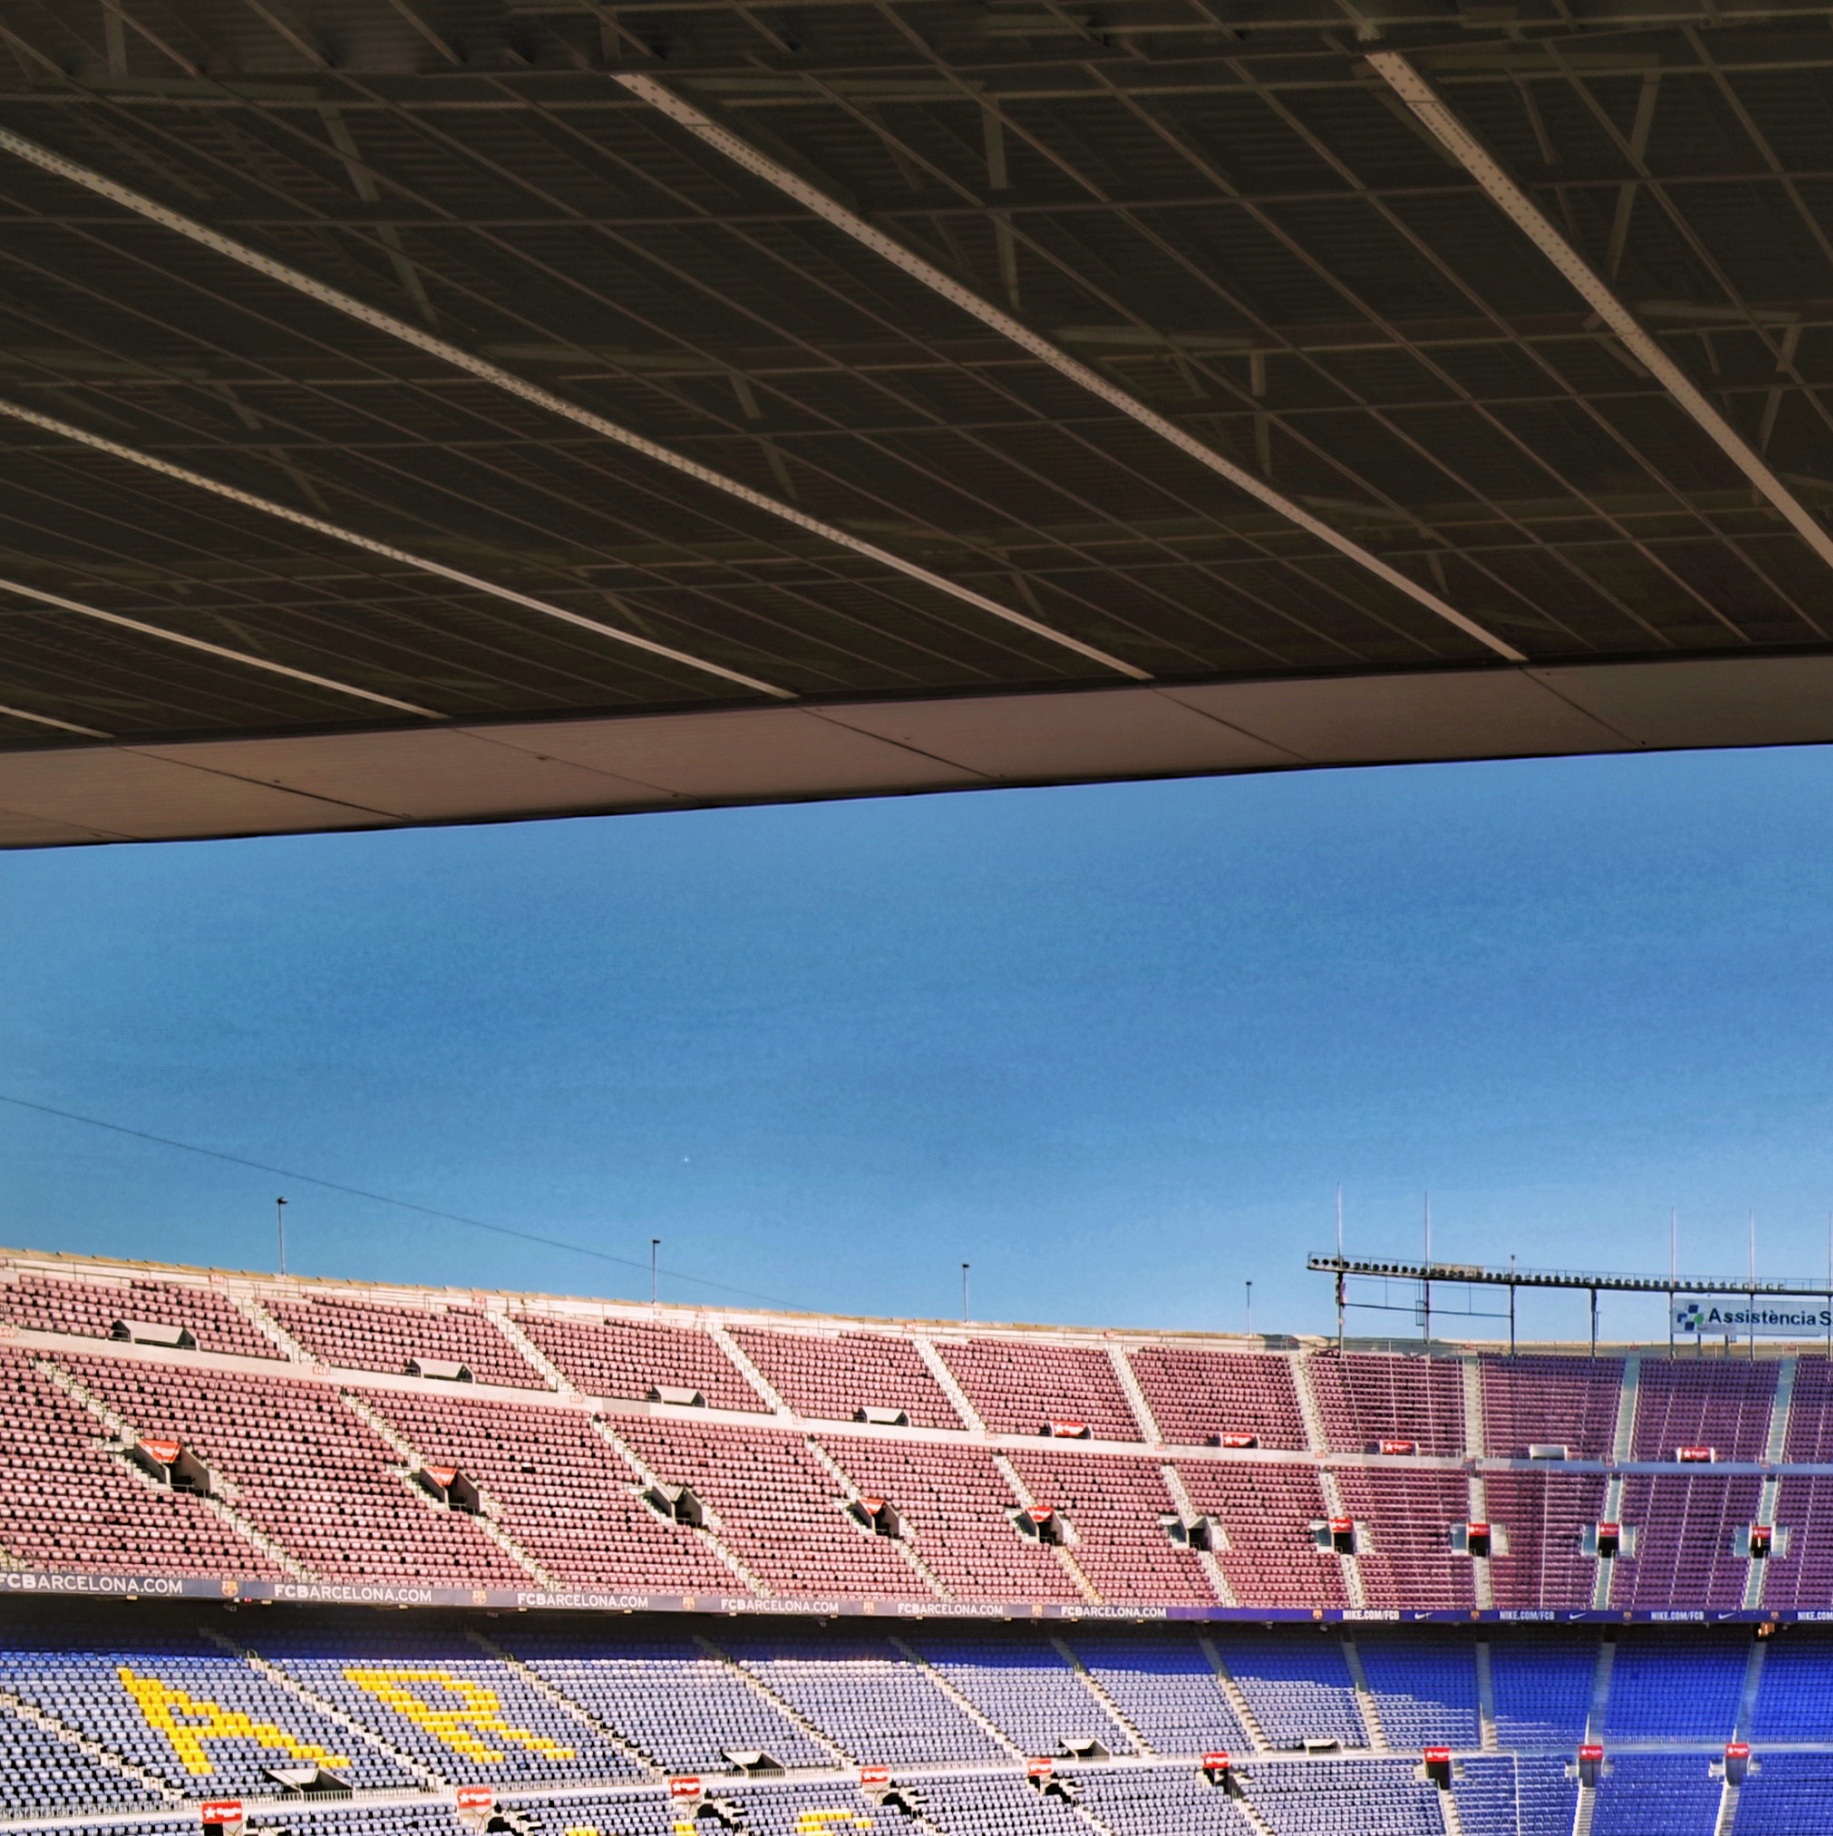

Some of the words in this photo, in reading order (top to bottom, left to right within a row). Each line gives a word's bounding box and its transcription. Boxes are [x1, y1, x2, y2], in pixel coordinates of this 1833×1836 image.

[1708, 1305, 1817, 1327] Assistència
[274, 1584, 432, 1603] FCBARCELONA.COM
[517, 1592, 648, 1608] FCBARCELONA.COM
[721, 1599, 838, 1613] FCBARCELONA.COM
[898, 1603, 1003, 1616] FCBARCELONA.COM
[1061, 1606, 1167, 1618] FCBARCELONA.COM
